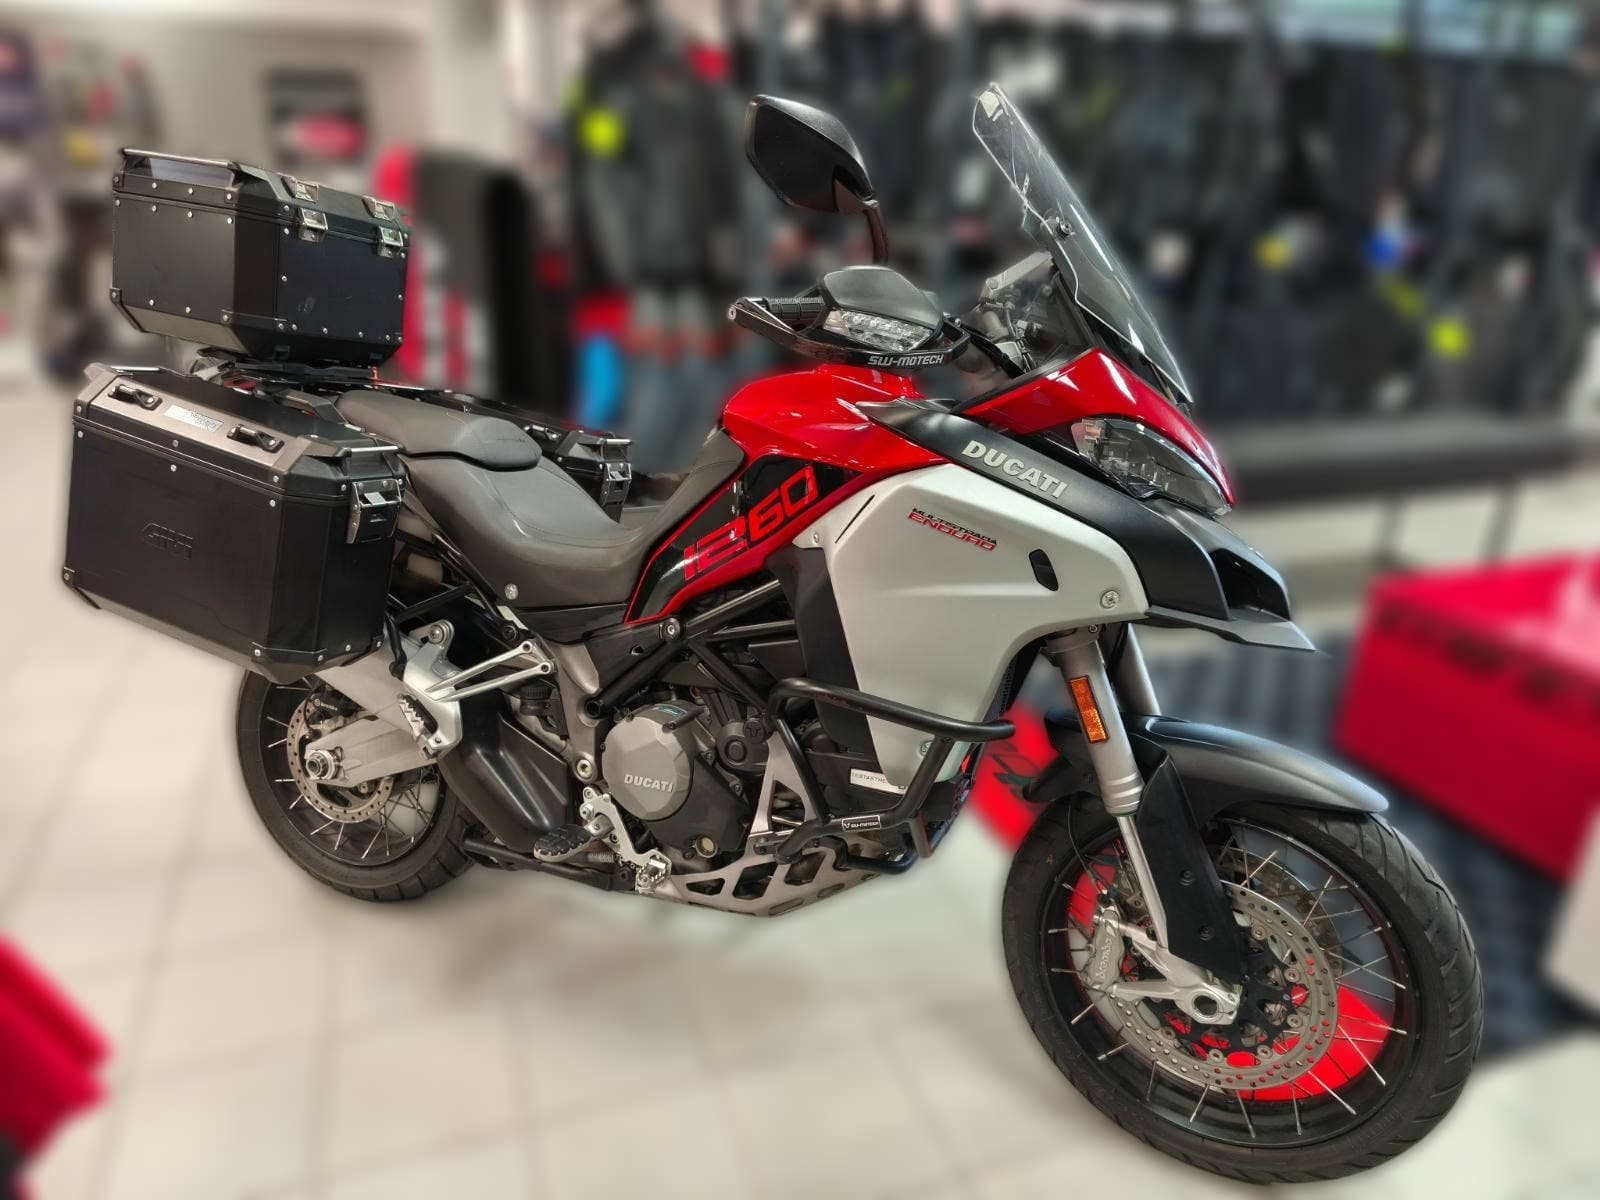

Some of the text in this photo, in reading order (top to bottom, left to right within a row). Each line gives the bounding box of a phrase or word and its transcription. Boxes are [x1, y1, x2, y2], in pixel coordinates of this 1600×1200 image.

[867, 354, 944, 367] SW-MOTECH
[961, 440, 1068, 499] DUCATI
[683, 465, 819, 581] 1260
[908, 511, 998, 552] ENDURO
[912, 508, 997, 545] MULTISTRADA
[624, 773, 674, 793] DUCATI
